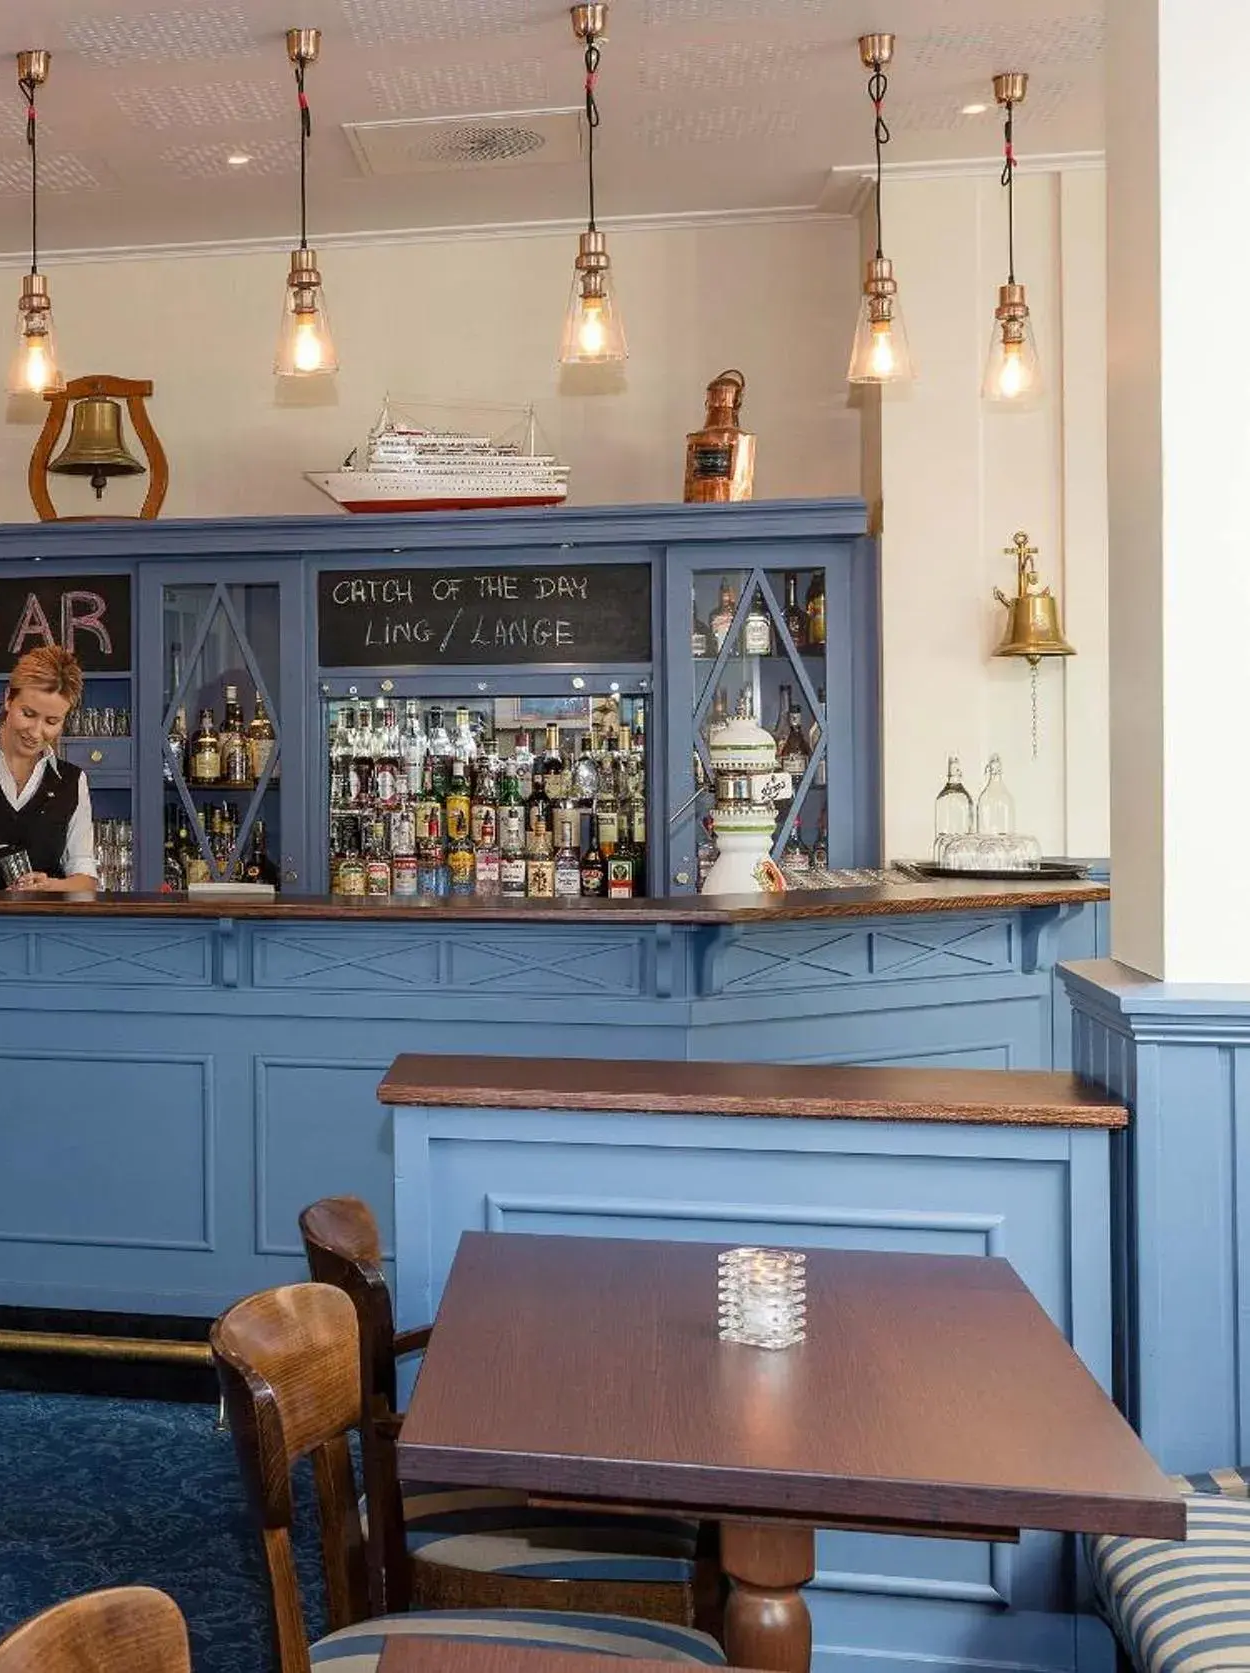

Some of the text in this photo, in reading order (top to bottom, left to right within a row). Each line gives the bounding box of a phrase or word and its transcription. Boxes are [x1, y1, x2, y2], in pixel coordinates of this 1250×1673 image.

[332, 574, 589, 605] CATCH OF THE DAY
